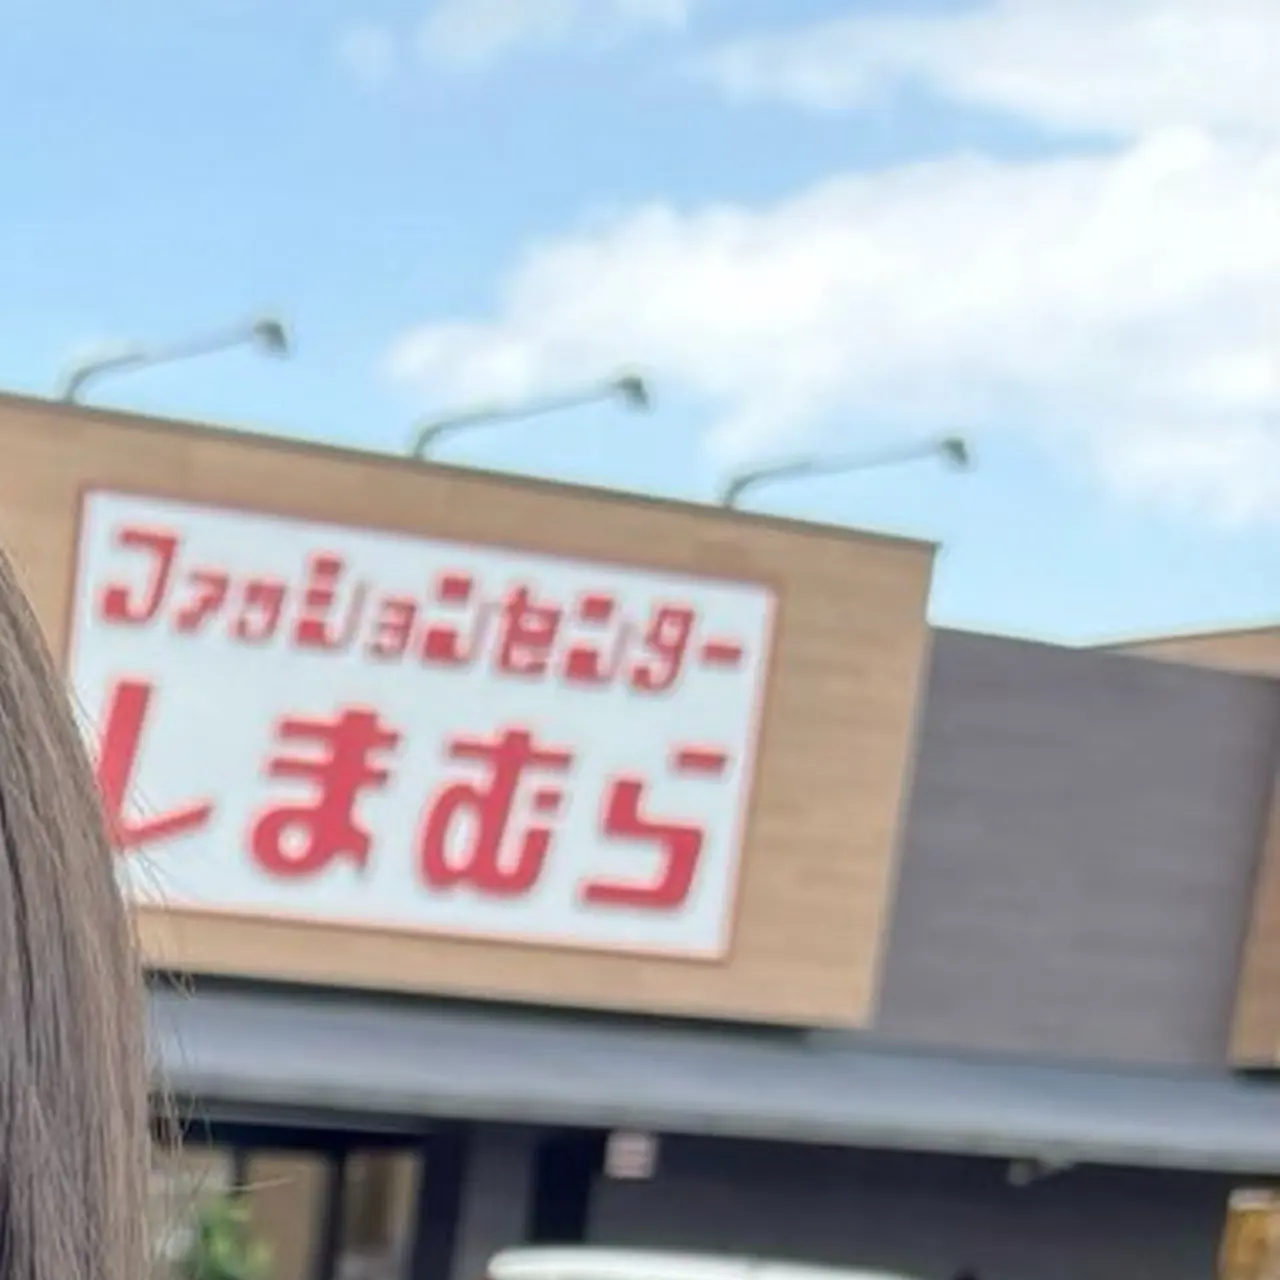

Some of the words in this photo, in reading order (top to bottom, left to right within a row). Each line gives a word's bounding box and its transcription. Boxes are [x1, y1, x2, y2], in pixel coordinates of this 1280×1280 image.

[101, 526, 745, 692] ファッションセンター
[94, 680, 728, 911] しまむら
